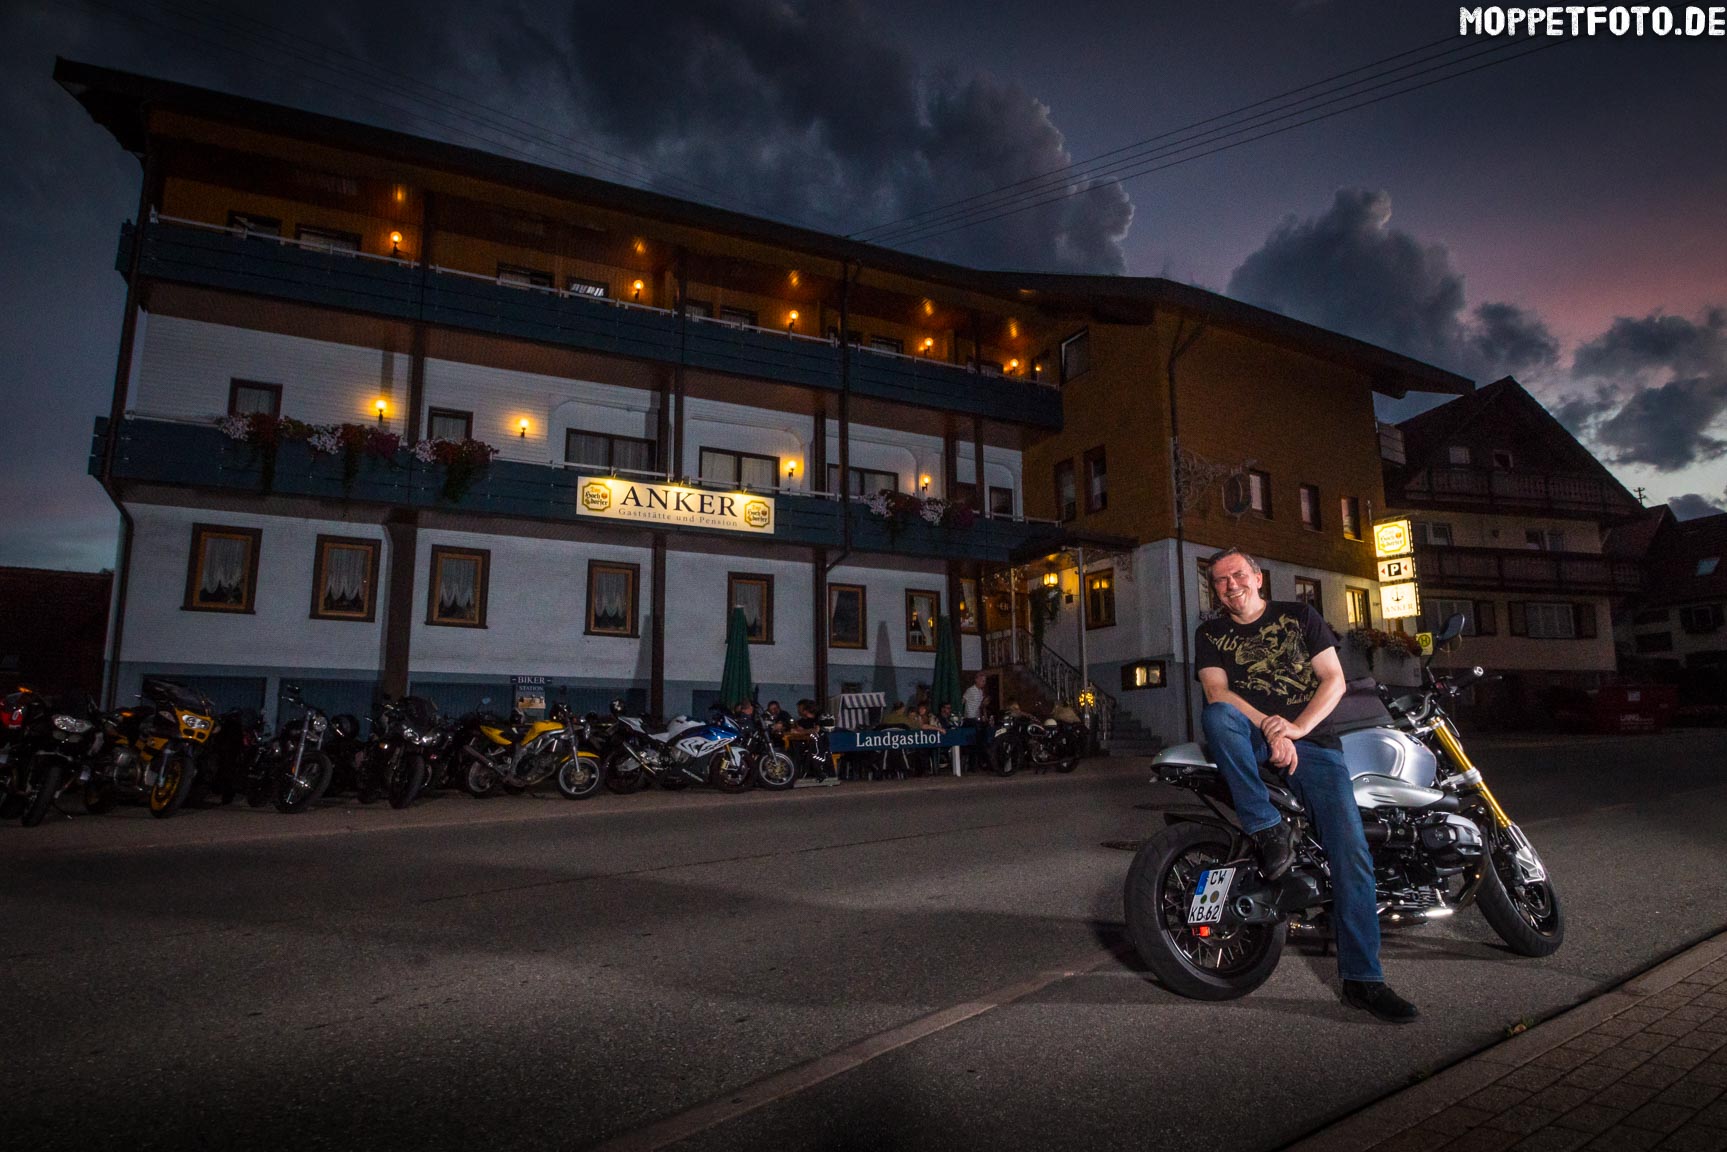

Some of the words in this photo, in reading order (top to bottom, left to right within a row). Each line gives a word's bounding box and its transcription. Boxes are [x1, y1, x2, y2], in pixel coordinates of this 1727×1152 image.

[620, 486, 738, 517] ANKER
[618, 508, 672, 520] Gaststätte
[676, 514, 695, 523] und
[699, 516, 738, 527] Pension
[1390, 564, 1400, 575] P
[1385, 603, 1414, 613] ANKER
[517, 676, 545, 684] BIKER
[1210, 870, 1227, 885] CW
